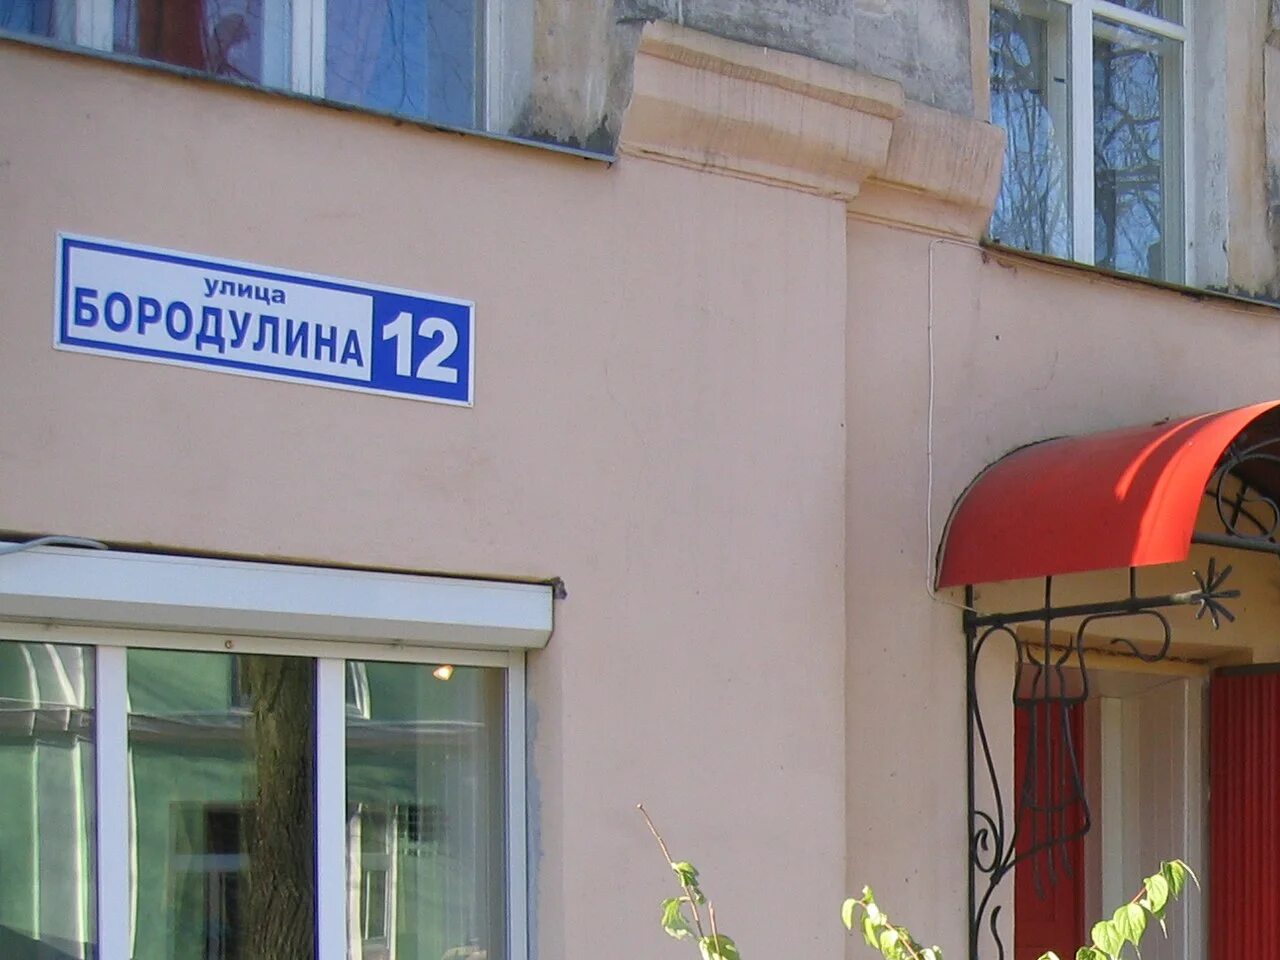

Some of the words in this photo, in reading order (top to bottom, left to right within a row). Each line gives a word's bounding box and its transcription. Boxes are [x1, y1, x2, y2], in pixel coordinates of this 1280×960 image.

[204, 276, 286, 304] улица
[74, 286, 364, 367] БОРОДУЛИНА
[382, 311, 459, 384] 12
